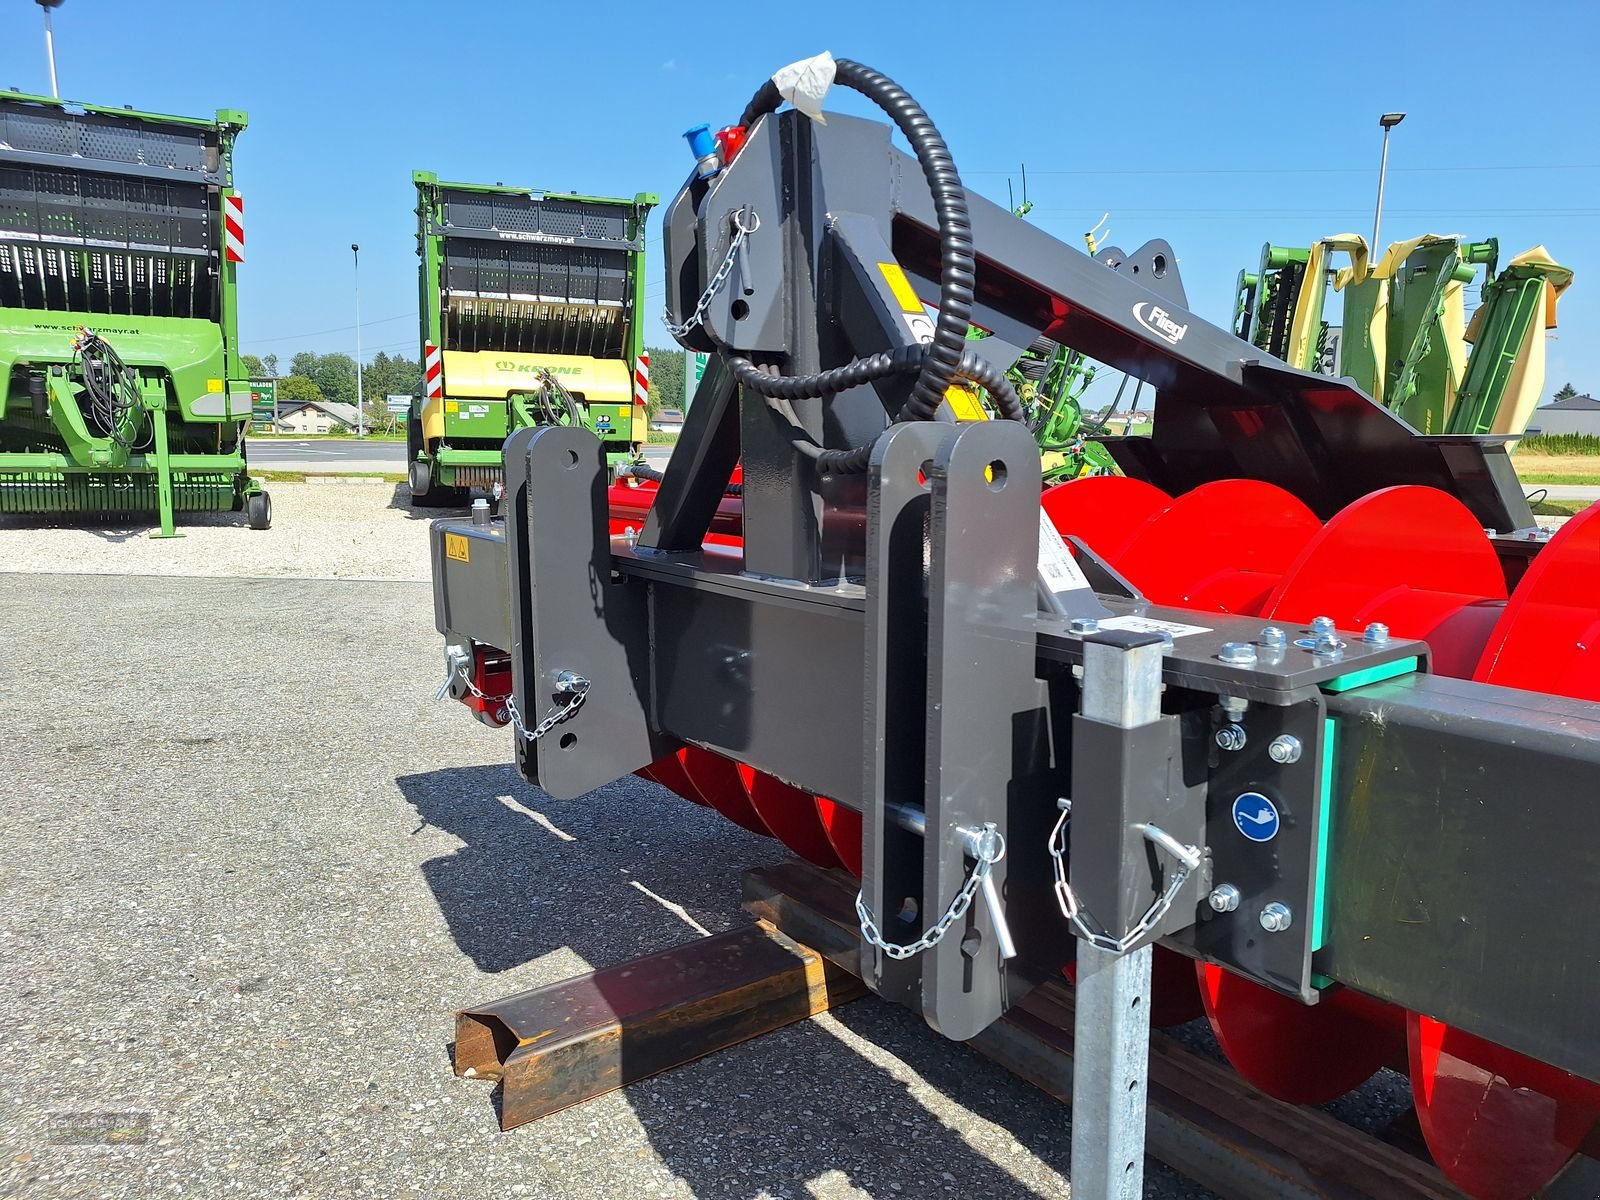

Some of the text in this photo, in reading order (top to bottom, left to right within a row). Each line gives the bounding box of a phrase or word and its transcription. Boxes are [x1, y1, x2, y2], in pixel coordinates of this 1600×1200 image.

[499, 232, 575, 244] www.schwarzmayr.at
[1147, 305, 1189, 342] Fliegl
[517, 364, 583, 375] KRONE
